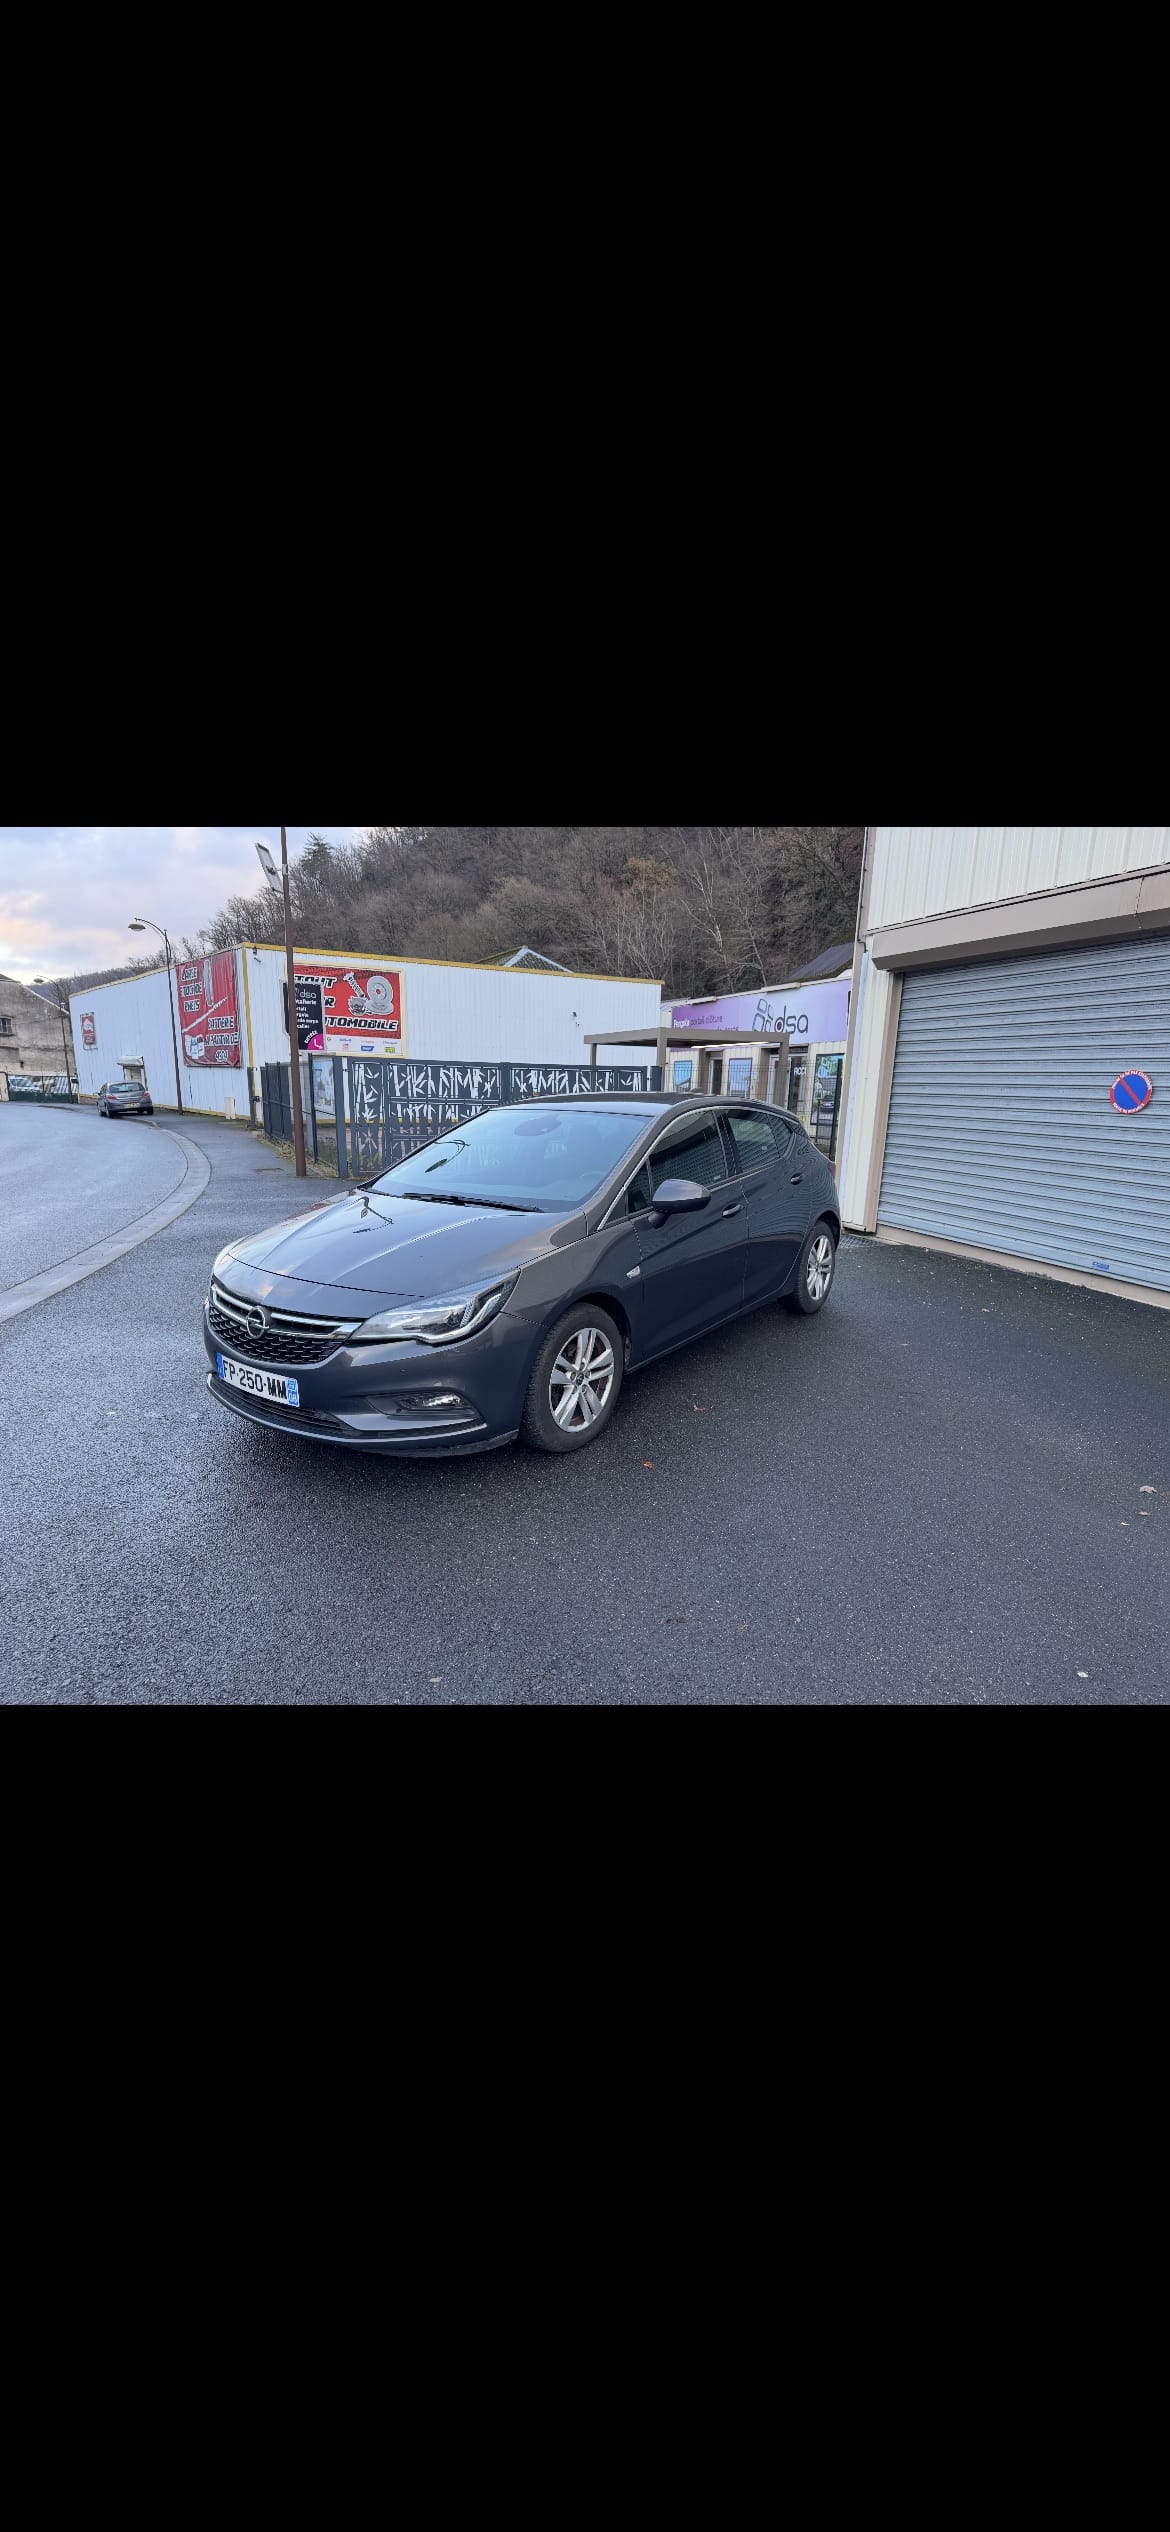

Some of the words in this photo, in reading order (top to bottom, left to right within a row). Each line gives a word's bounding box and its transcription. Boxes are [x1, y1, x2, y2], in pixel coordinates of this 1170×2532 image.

[300, 988, 317, 998] dsa
[774, 1005, 809, 1034] dsa
[222, 1360, 288, 1400] FP-250-MM
